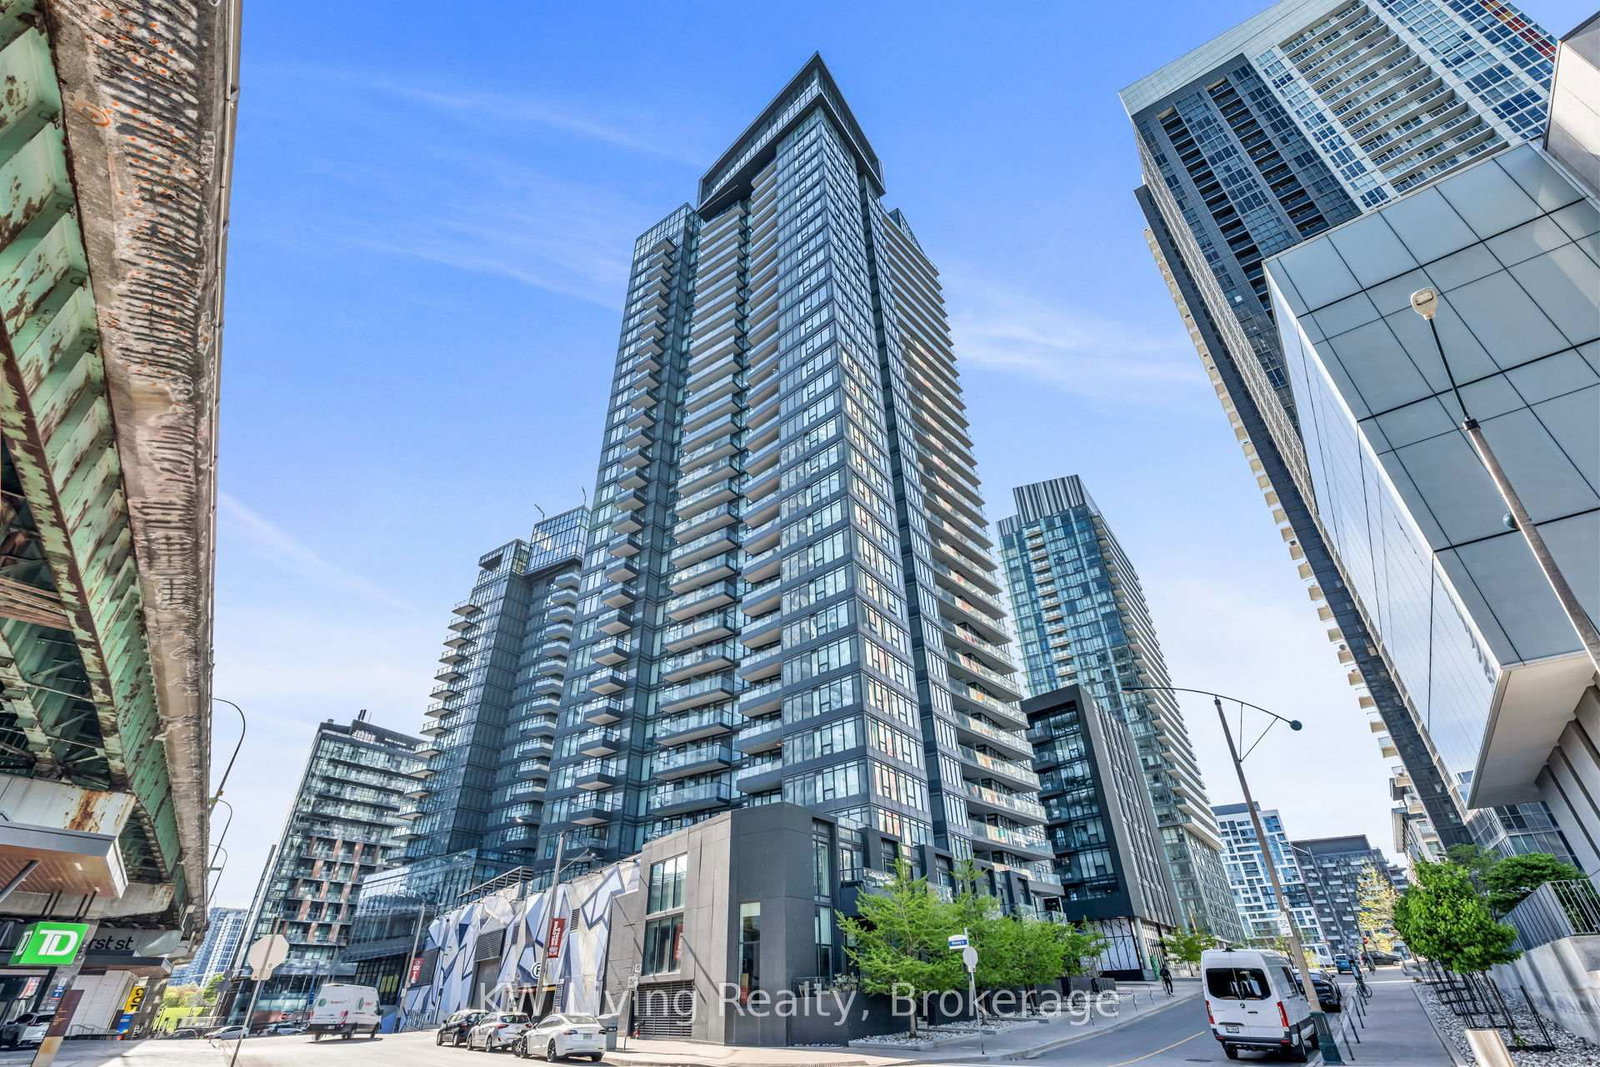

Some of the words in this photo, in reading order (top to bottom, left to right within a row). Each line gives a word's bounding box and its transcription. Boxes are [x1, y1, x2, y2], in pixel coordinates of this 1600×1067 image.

[38, 929, 78, 956] TD
[88, 935, 114, 950] rst
[115, 936, 134, 950] st
